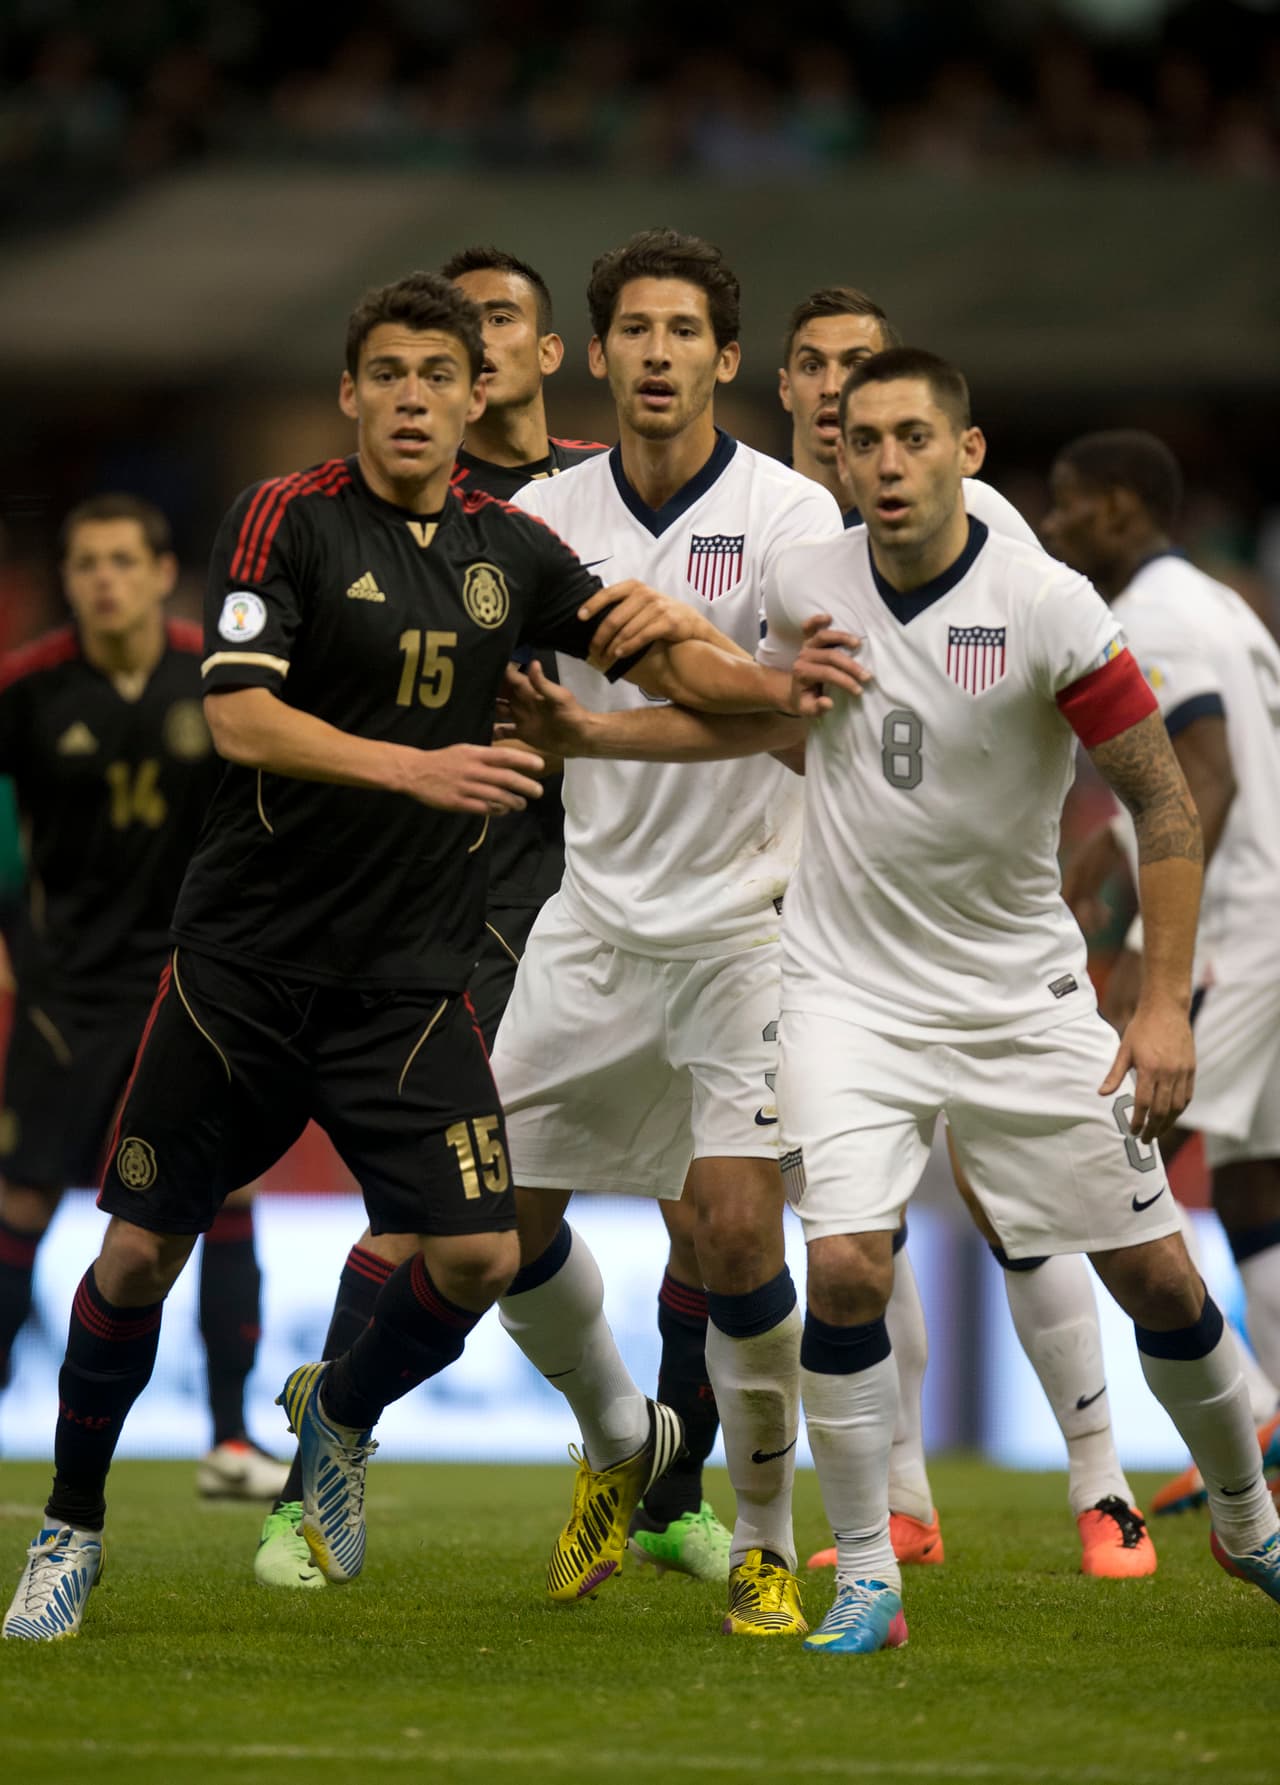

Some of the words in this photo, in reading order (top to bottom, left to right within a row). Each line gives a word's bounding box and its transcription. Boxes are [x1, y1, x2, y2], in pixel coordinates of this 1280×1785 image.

[395, 628, 458, 709] 15
[881, 708, 923, 790] 8
[444, 1113, 510, 1200] 15
